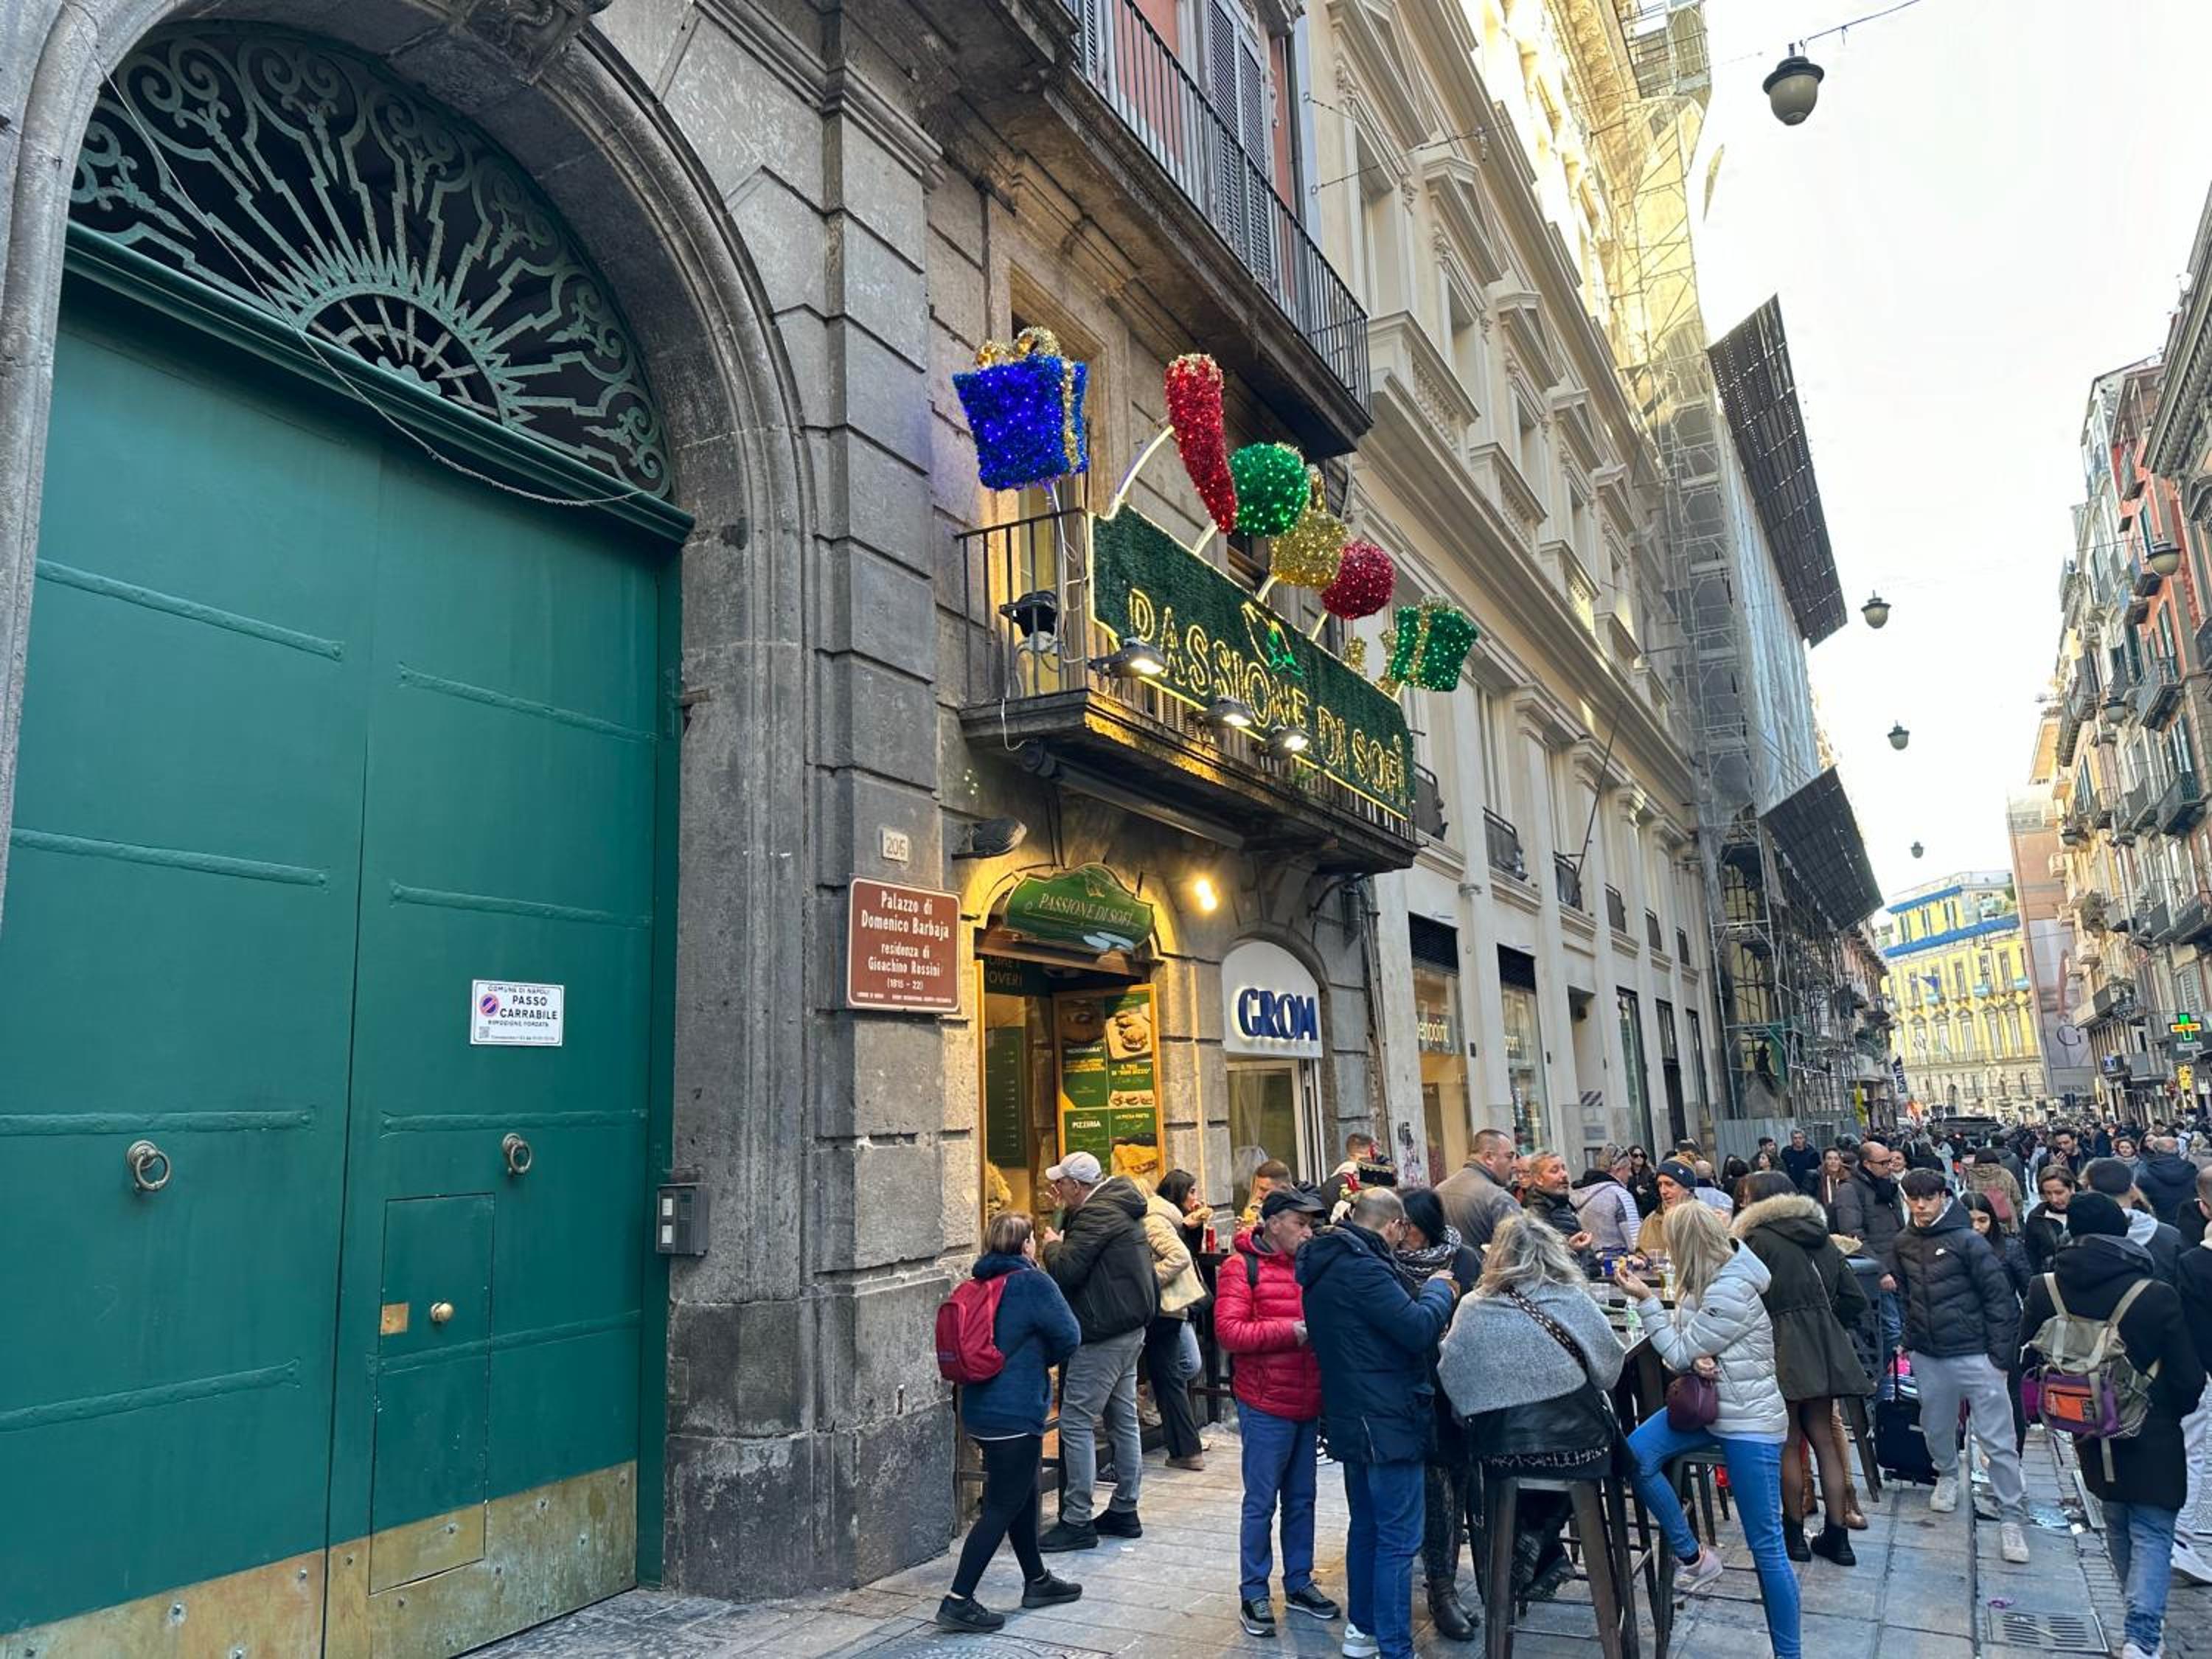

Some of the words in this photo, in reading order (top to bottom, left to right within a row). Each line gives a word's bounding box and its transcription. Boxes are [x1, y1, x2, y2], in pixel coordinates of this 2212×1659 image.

[1317, 706, 1349, 776] DI
[880, 890, 919, 914] Palazzo
[923, 898, 933, 916] di
[1038, 893, 1093, 919] PASSIONE
[1094, 904, 1110, 922] DI
[860, 909, 909, 933] Domenico
[912, 917, 950, 942] Barbaja
[881, 942, 919, 959] residenza
[922, 944, 931, 959] di
[868, 956, 908, 974] Gioachino
[911, 960, 941, 976] Rossini
[512, 995, 548, 1006] PASSO
[499, 1008, 558, 1020] CARRABILE
[1237, 987, 1319, 1042] GROM
